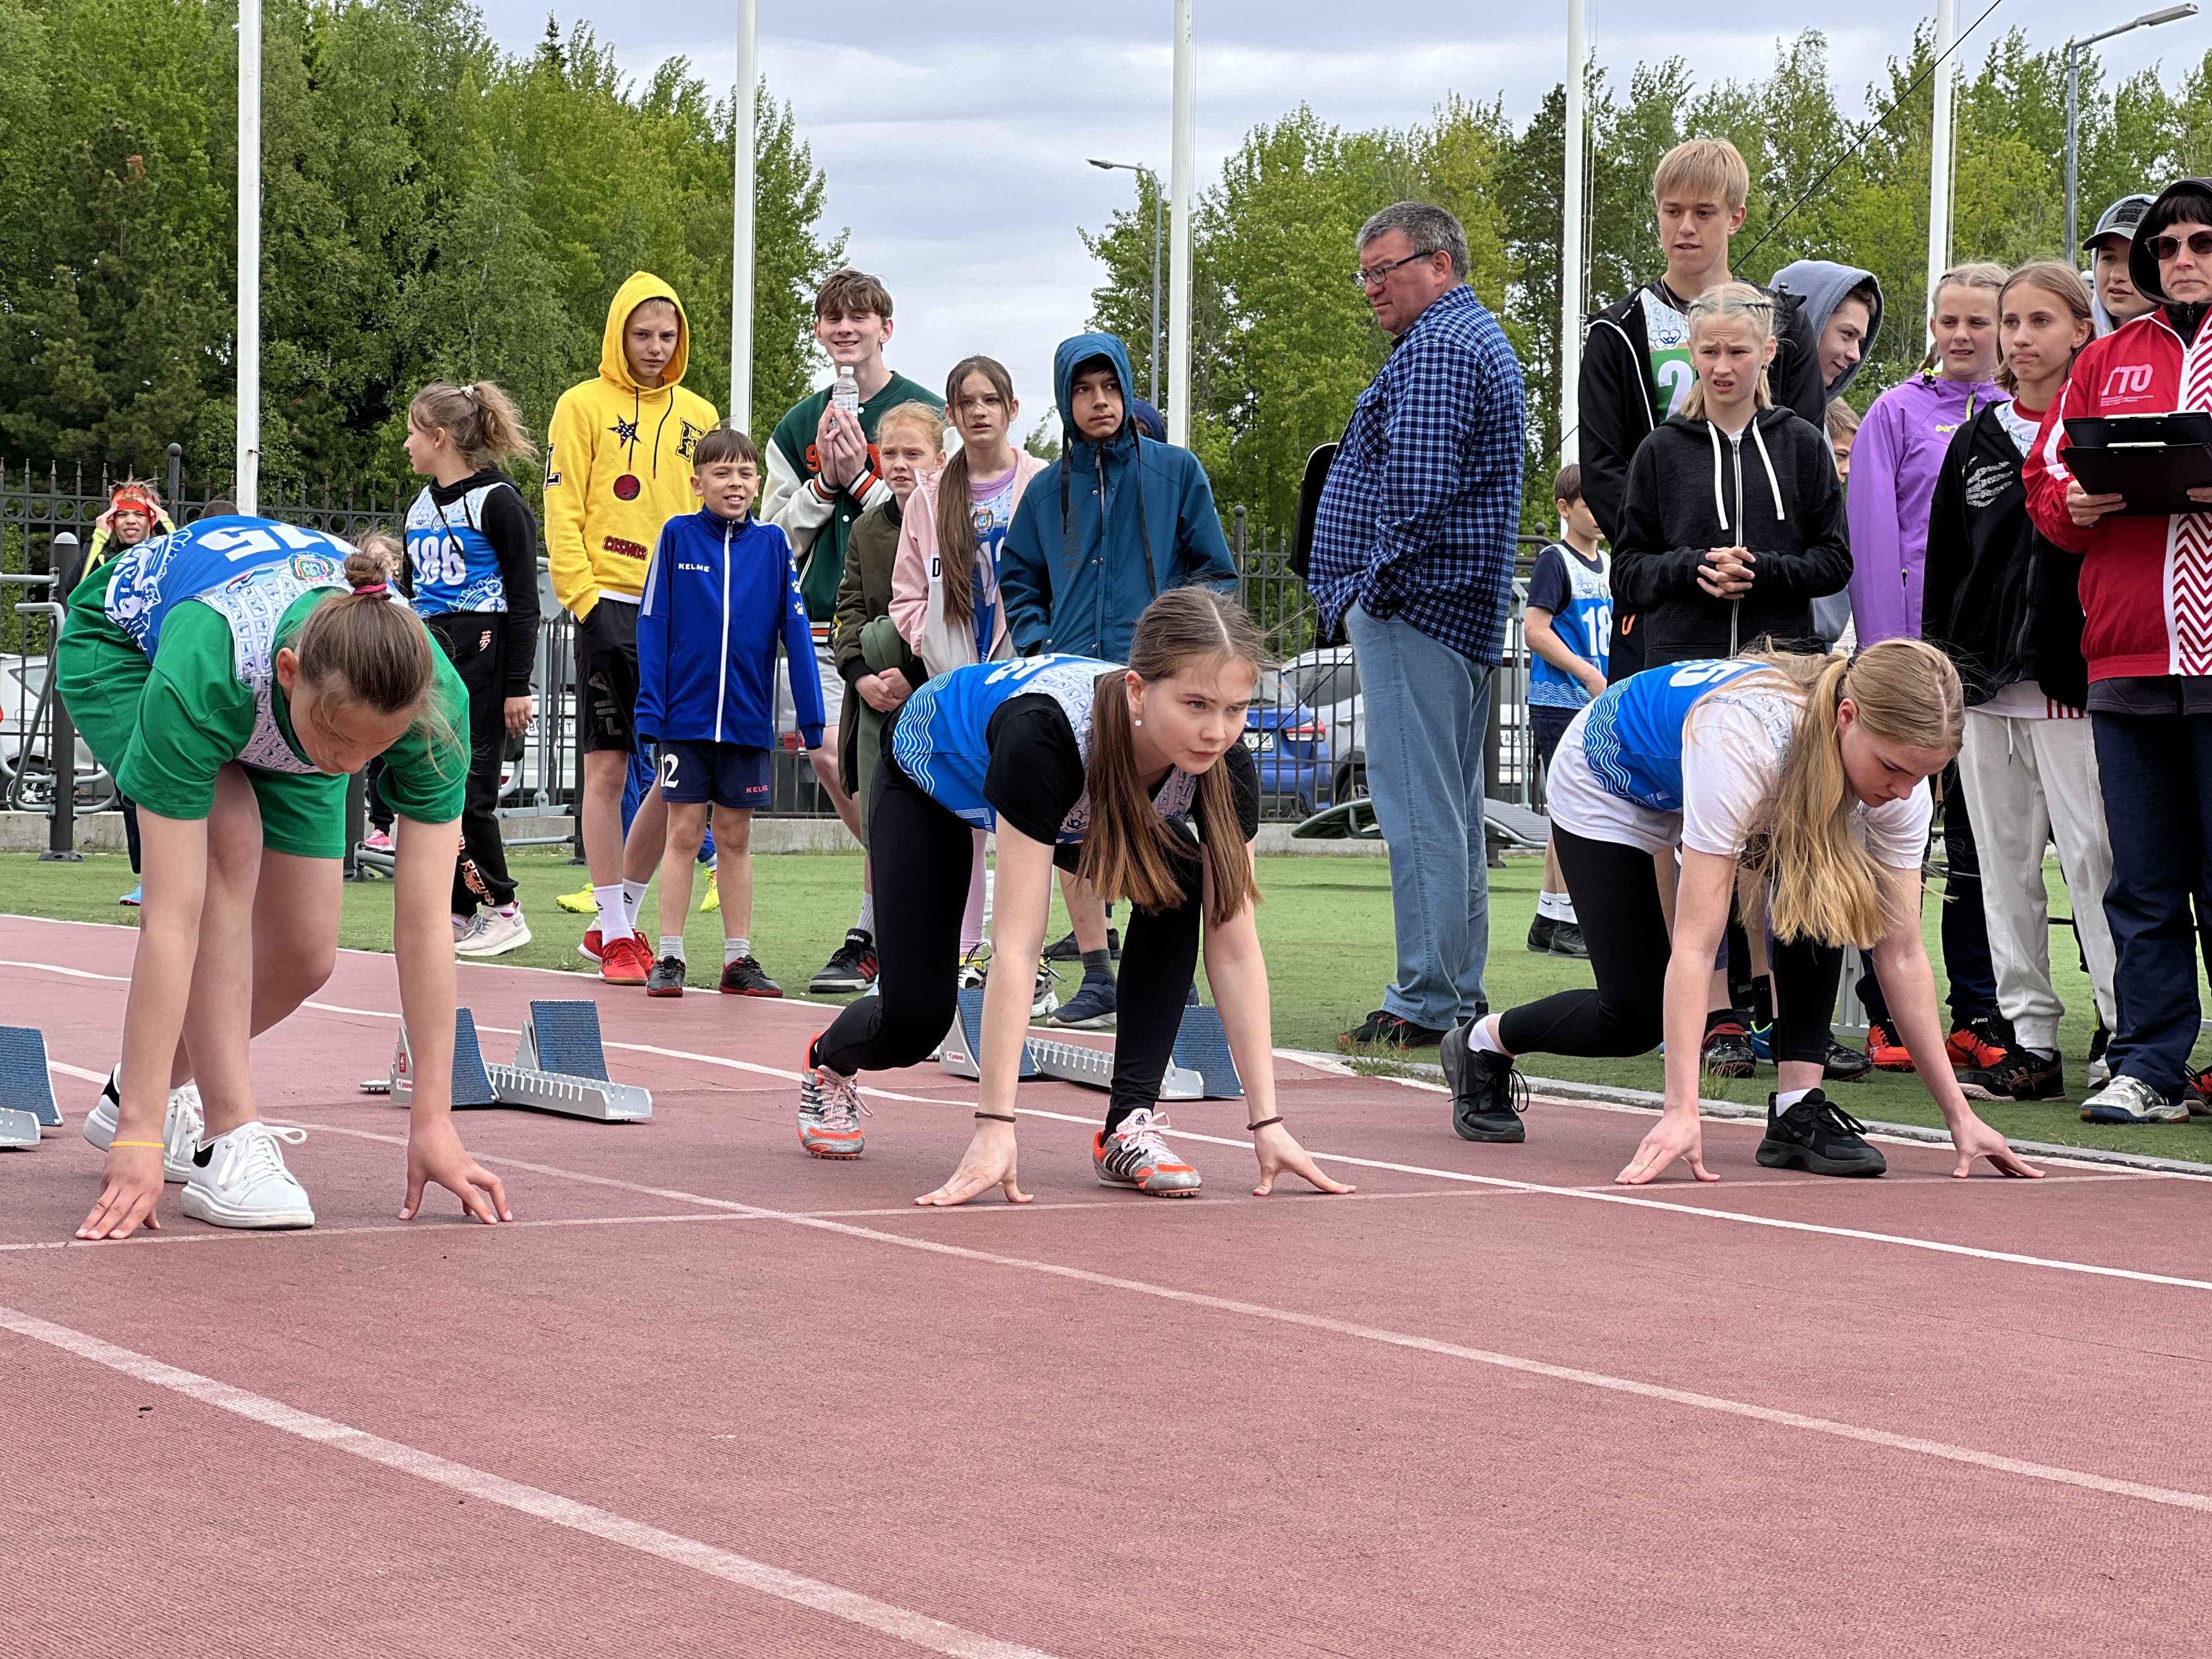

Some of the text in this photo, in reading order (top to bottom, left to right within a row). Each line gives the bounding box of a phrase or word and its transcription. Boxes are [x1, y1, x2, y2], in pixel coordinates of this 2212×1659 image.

[407, 535, 466, 585] 186
[678, 563, 710, 572] KELME
[660, 753, 679, 788] 12
[846, 934, 864, 943] adidas
